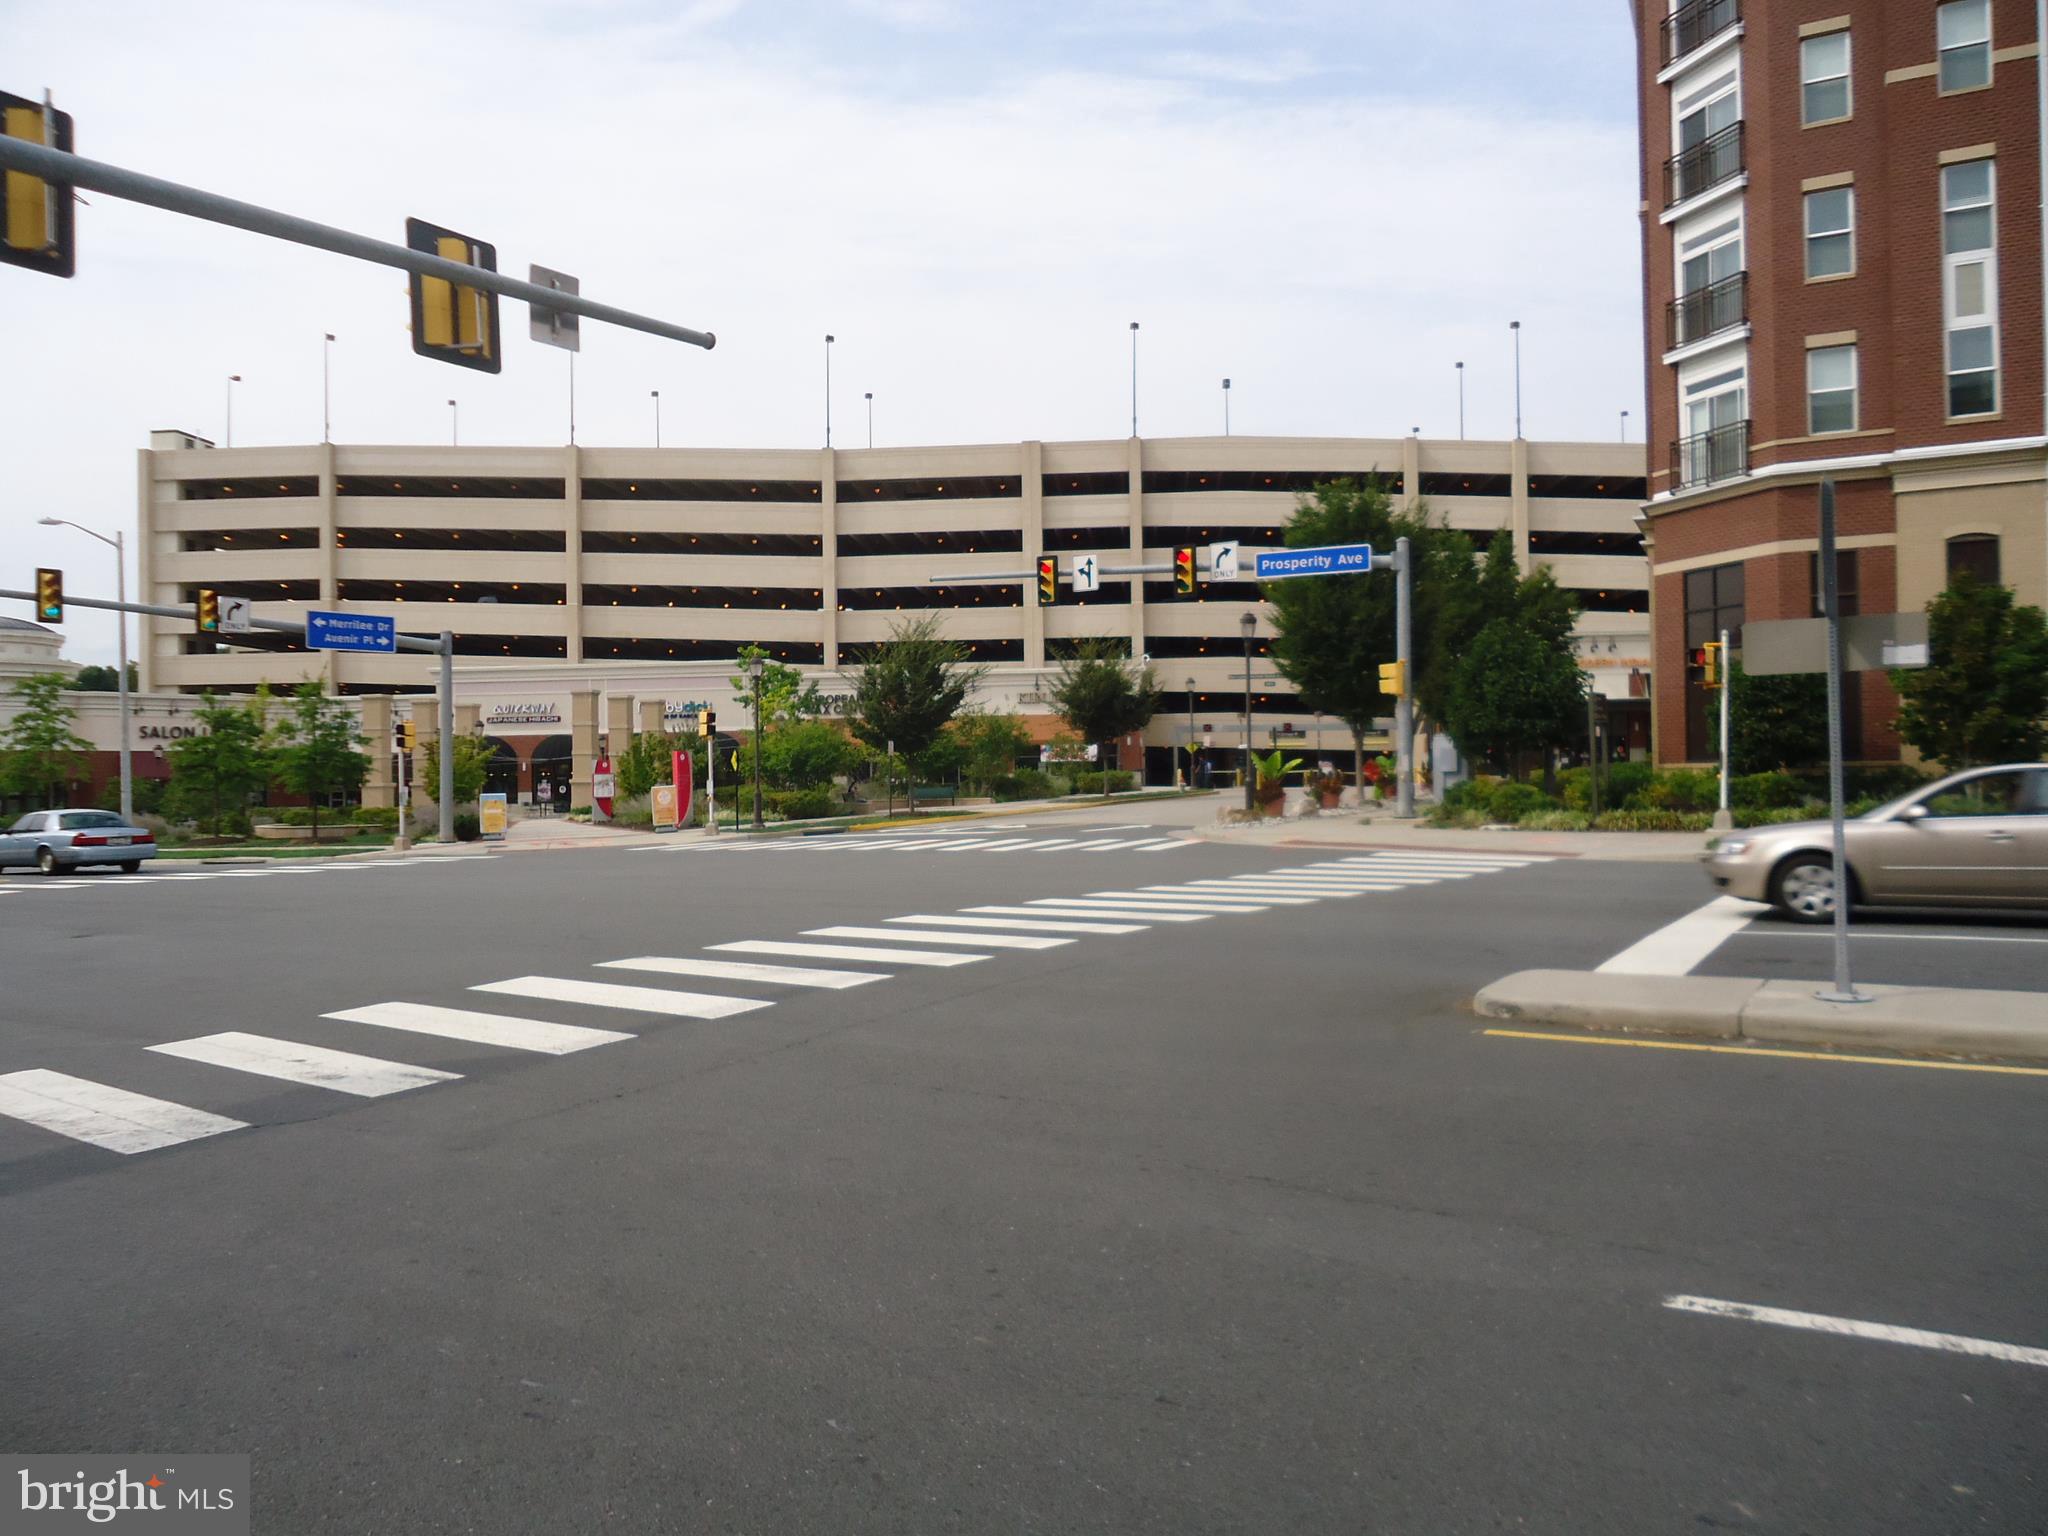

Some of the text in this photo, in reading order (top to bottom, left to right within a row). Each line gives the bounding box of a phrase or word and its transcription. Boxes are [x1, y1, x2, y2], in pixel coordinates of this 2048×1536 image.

[1262, 554, 1363, 571] Prosperity Ave
[1214, 570, 1234, 578] ONLY
[225, 622, 245, 630] ONLY
[329, 619, 389, 632] Merrilee Dr
[324, 634, 374, 644] Avenir Pl
[139, 726, 196, 739] SALON
